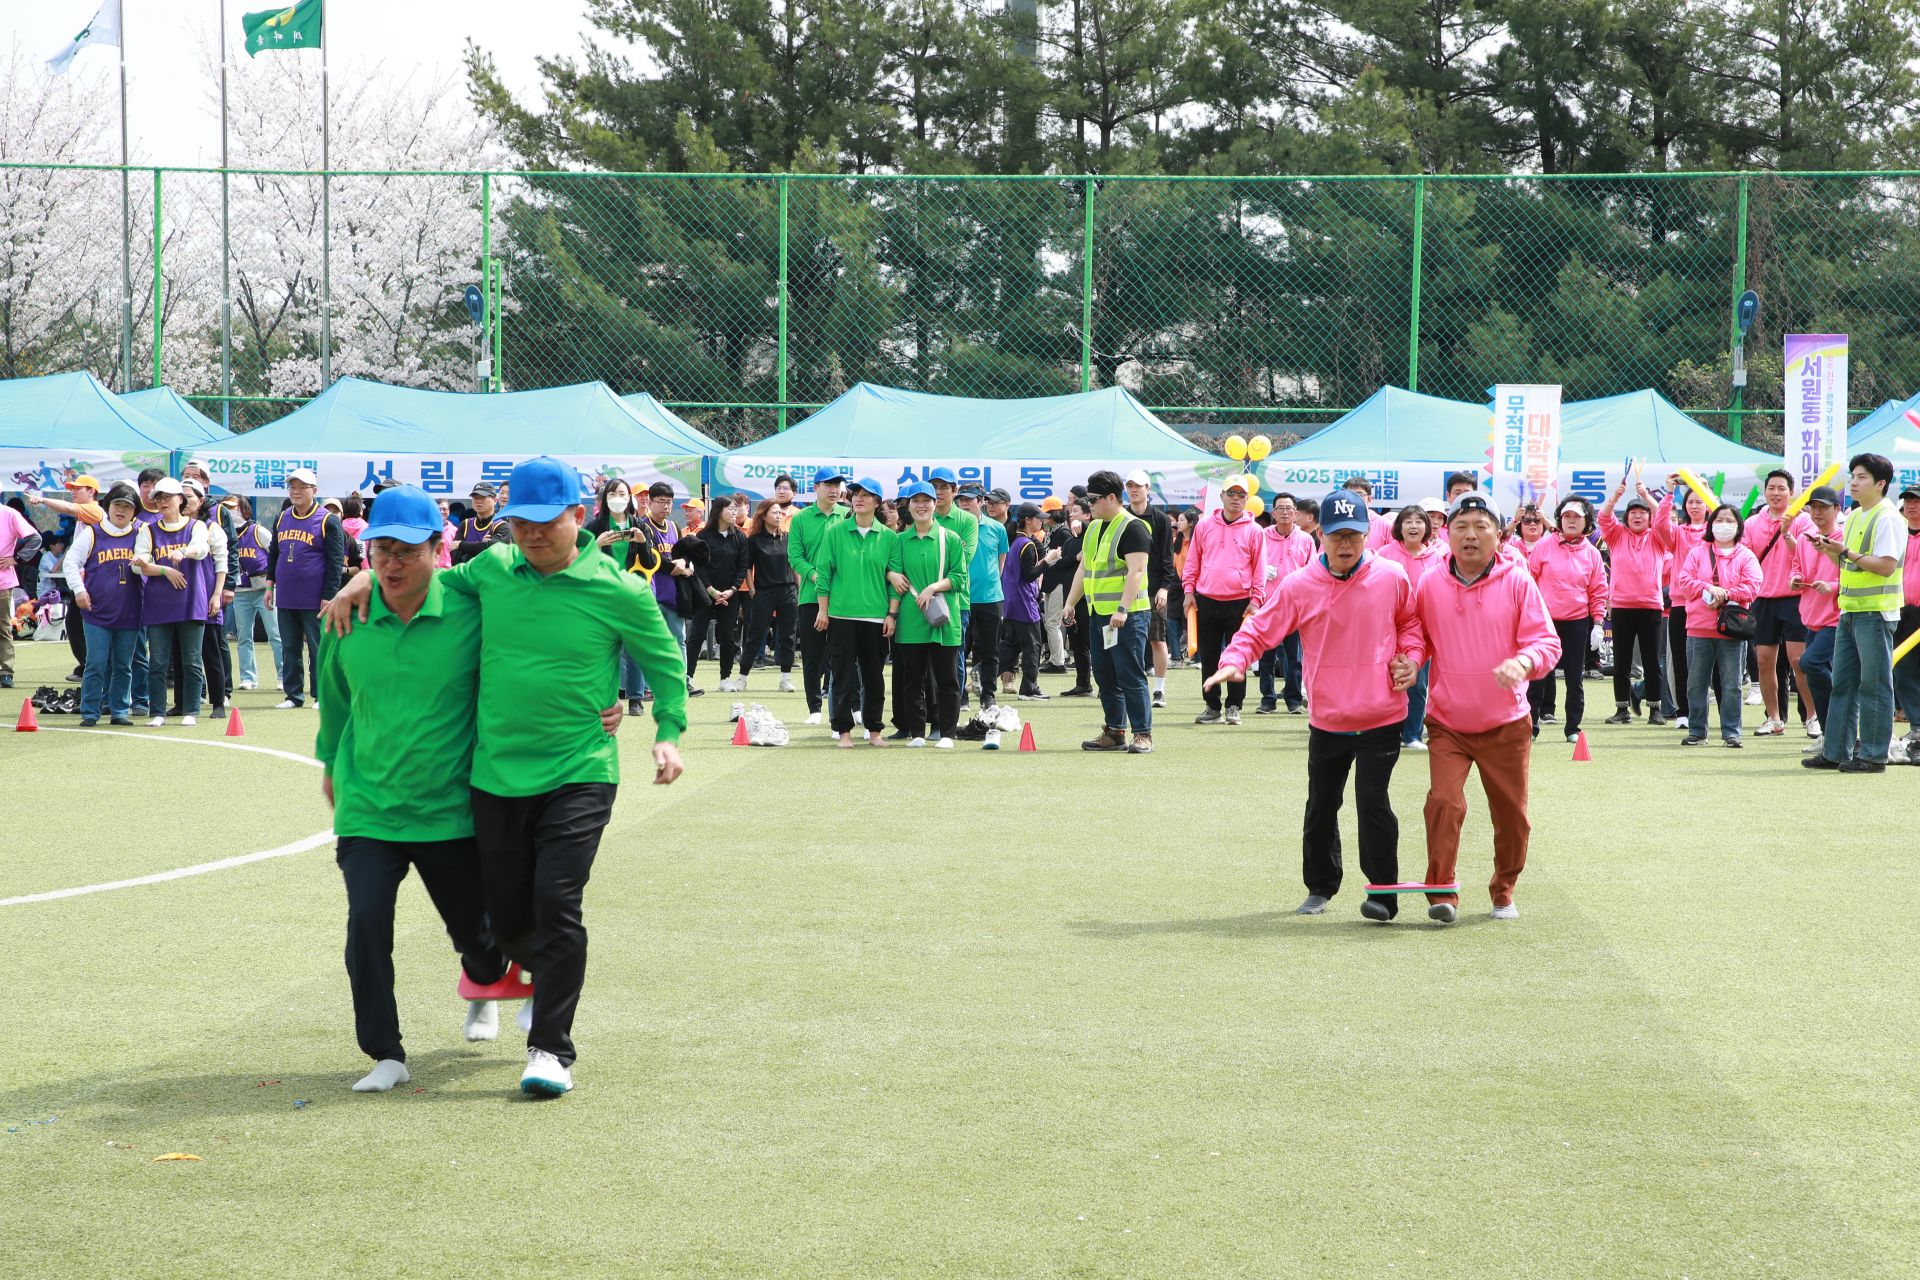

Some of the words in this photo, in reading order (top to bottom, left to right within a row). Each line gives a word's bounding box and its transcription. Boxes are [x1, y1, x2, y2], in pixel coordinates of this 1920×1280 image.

[1801, 355, 1822, 424] 서원동
[1504, 395, 1525, 472] 무적함대
[1527, 414, 1551, 490] 대학동
[208, 459, 251, 473] 2025
[743, 464, 787, 479] 2025
[1285, 469, 1329, 484] 2025
[1334, 499, 1355, 518] NY
[278, 529, 315, 546] DAEHAK
[287, 543, 295, 562] 1
[118, 562, 127, 584] 1
